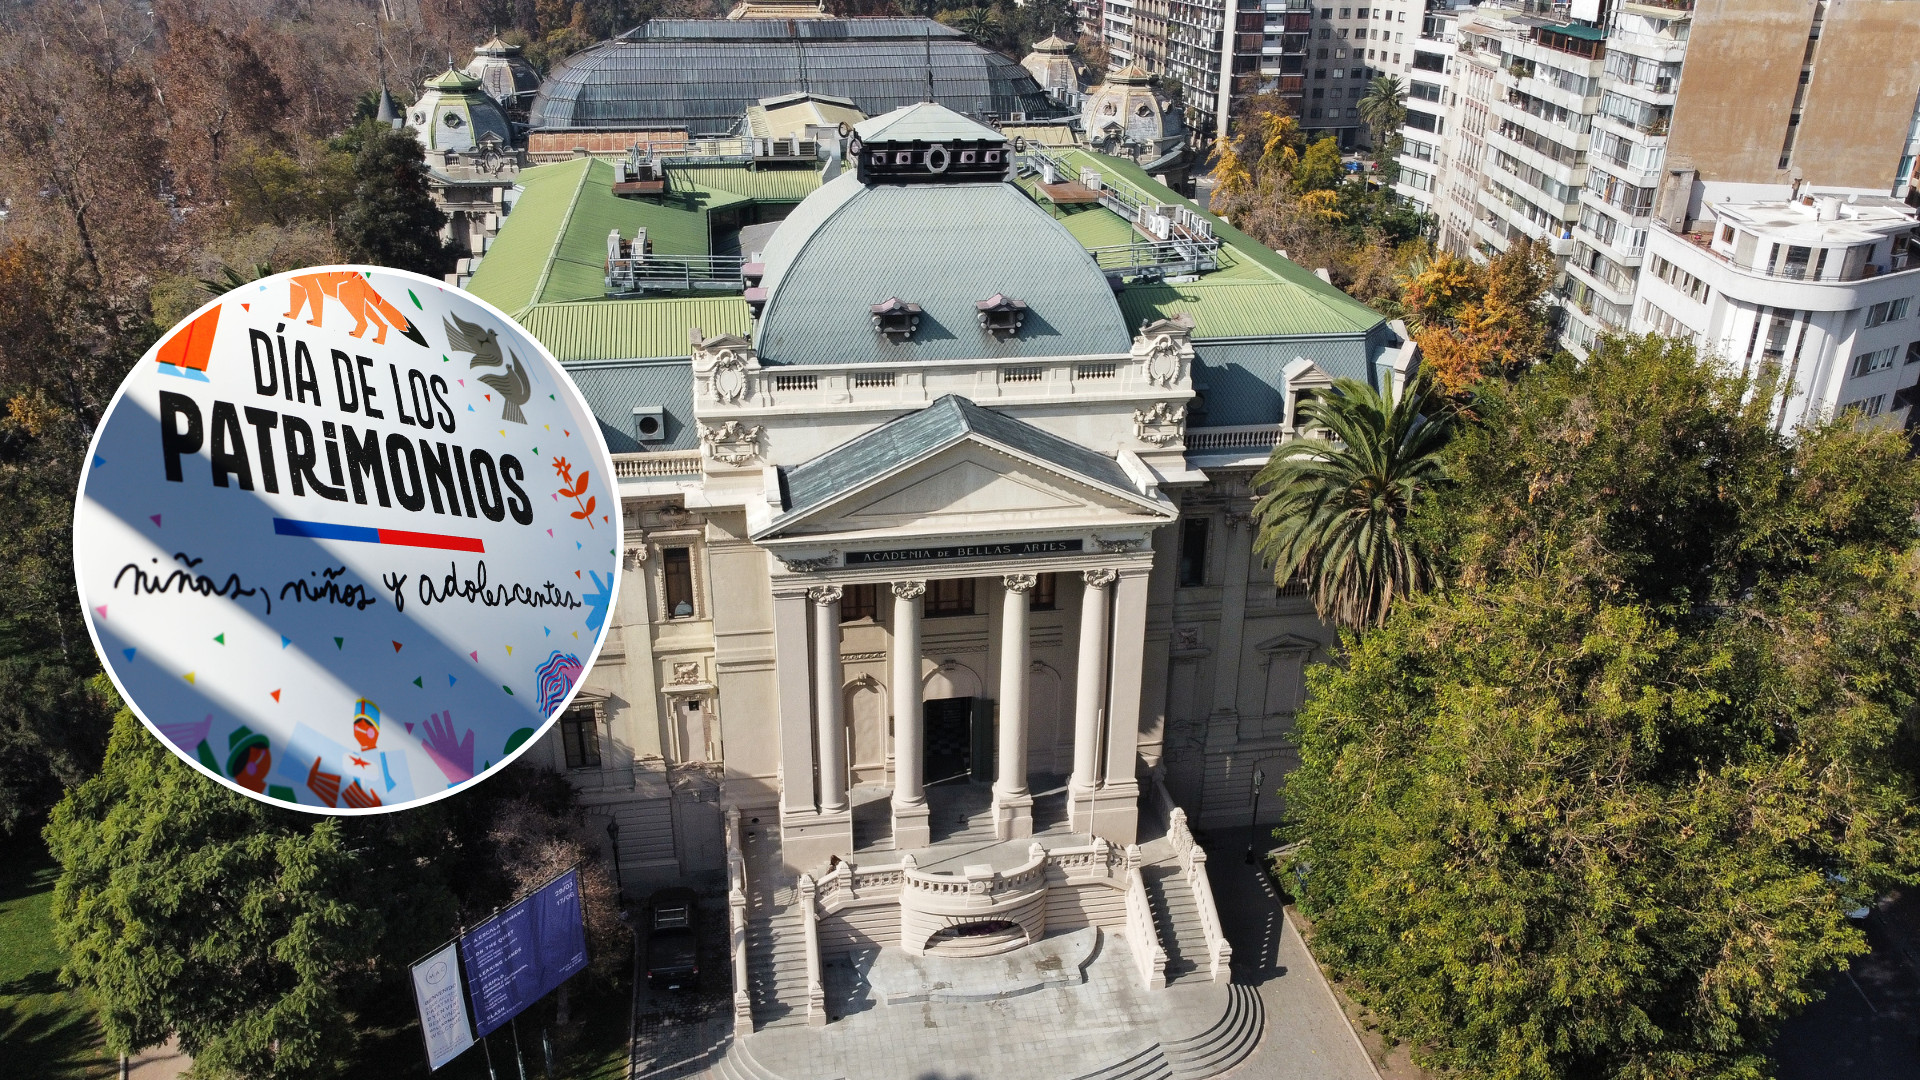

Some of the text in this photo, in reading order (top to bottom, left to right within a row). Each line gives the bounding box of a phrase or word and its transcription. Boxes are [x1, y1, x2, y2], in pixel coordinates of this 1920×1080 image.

[248, 322, 456, 434] DÍA DE LOS
[863, 549, 931, 562] ACADEMIA
[957, 544, 1012, 556] BELLAS
[1023, 541, 1067, 553] ARTES
[114, 552, 582, 615] niñas, niños y adolescentes
[478, 924, 501, 940] ESCALA
[485, 940, 497, 951] THE
[497, 929, 514, 943] QUIET
